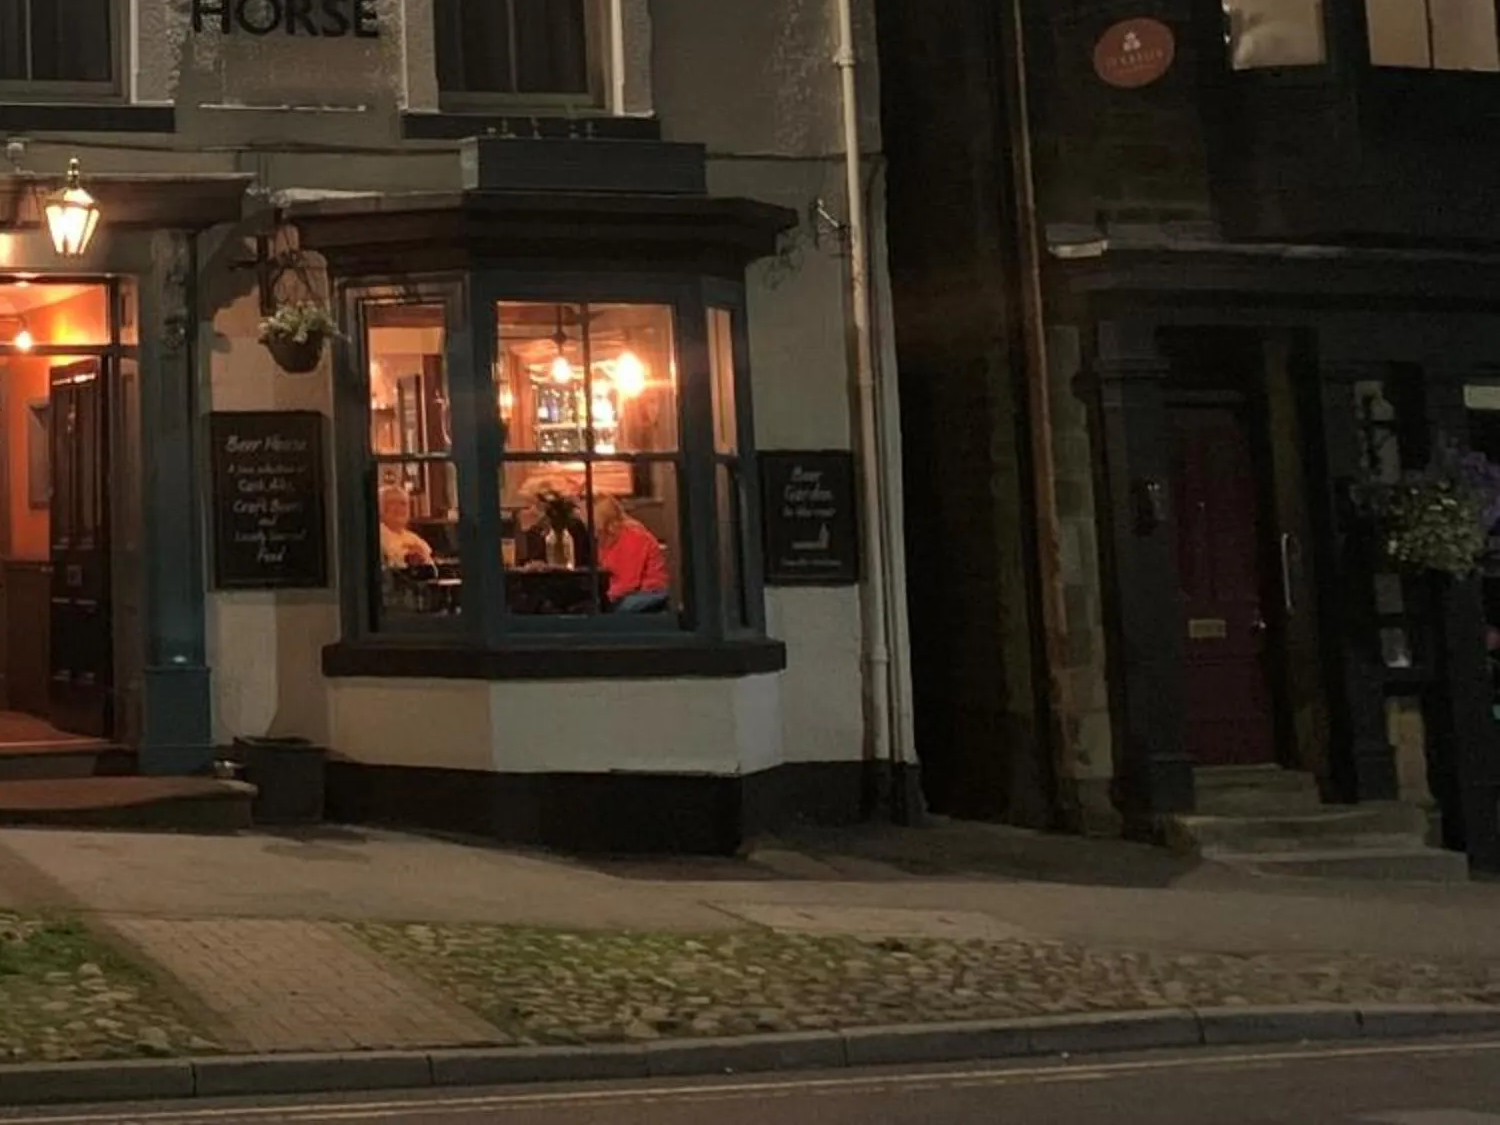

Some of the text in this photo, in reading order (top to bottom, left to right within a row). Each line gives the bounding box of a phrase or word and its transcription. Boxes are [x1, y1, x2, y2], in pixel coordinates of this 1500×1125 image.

[224, 433, 307, 453] Beer House
[256, 543, 287, 564] Food
